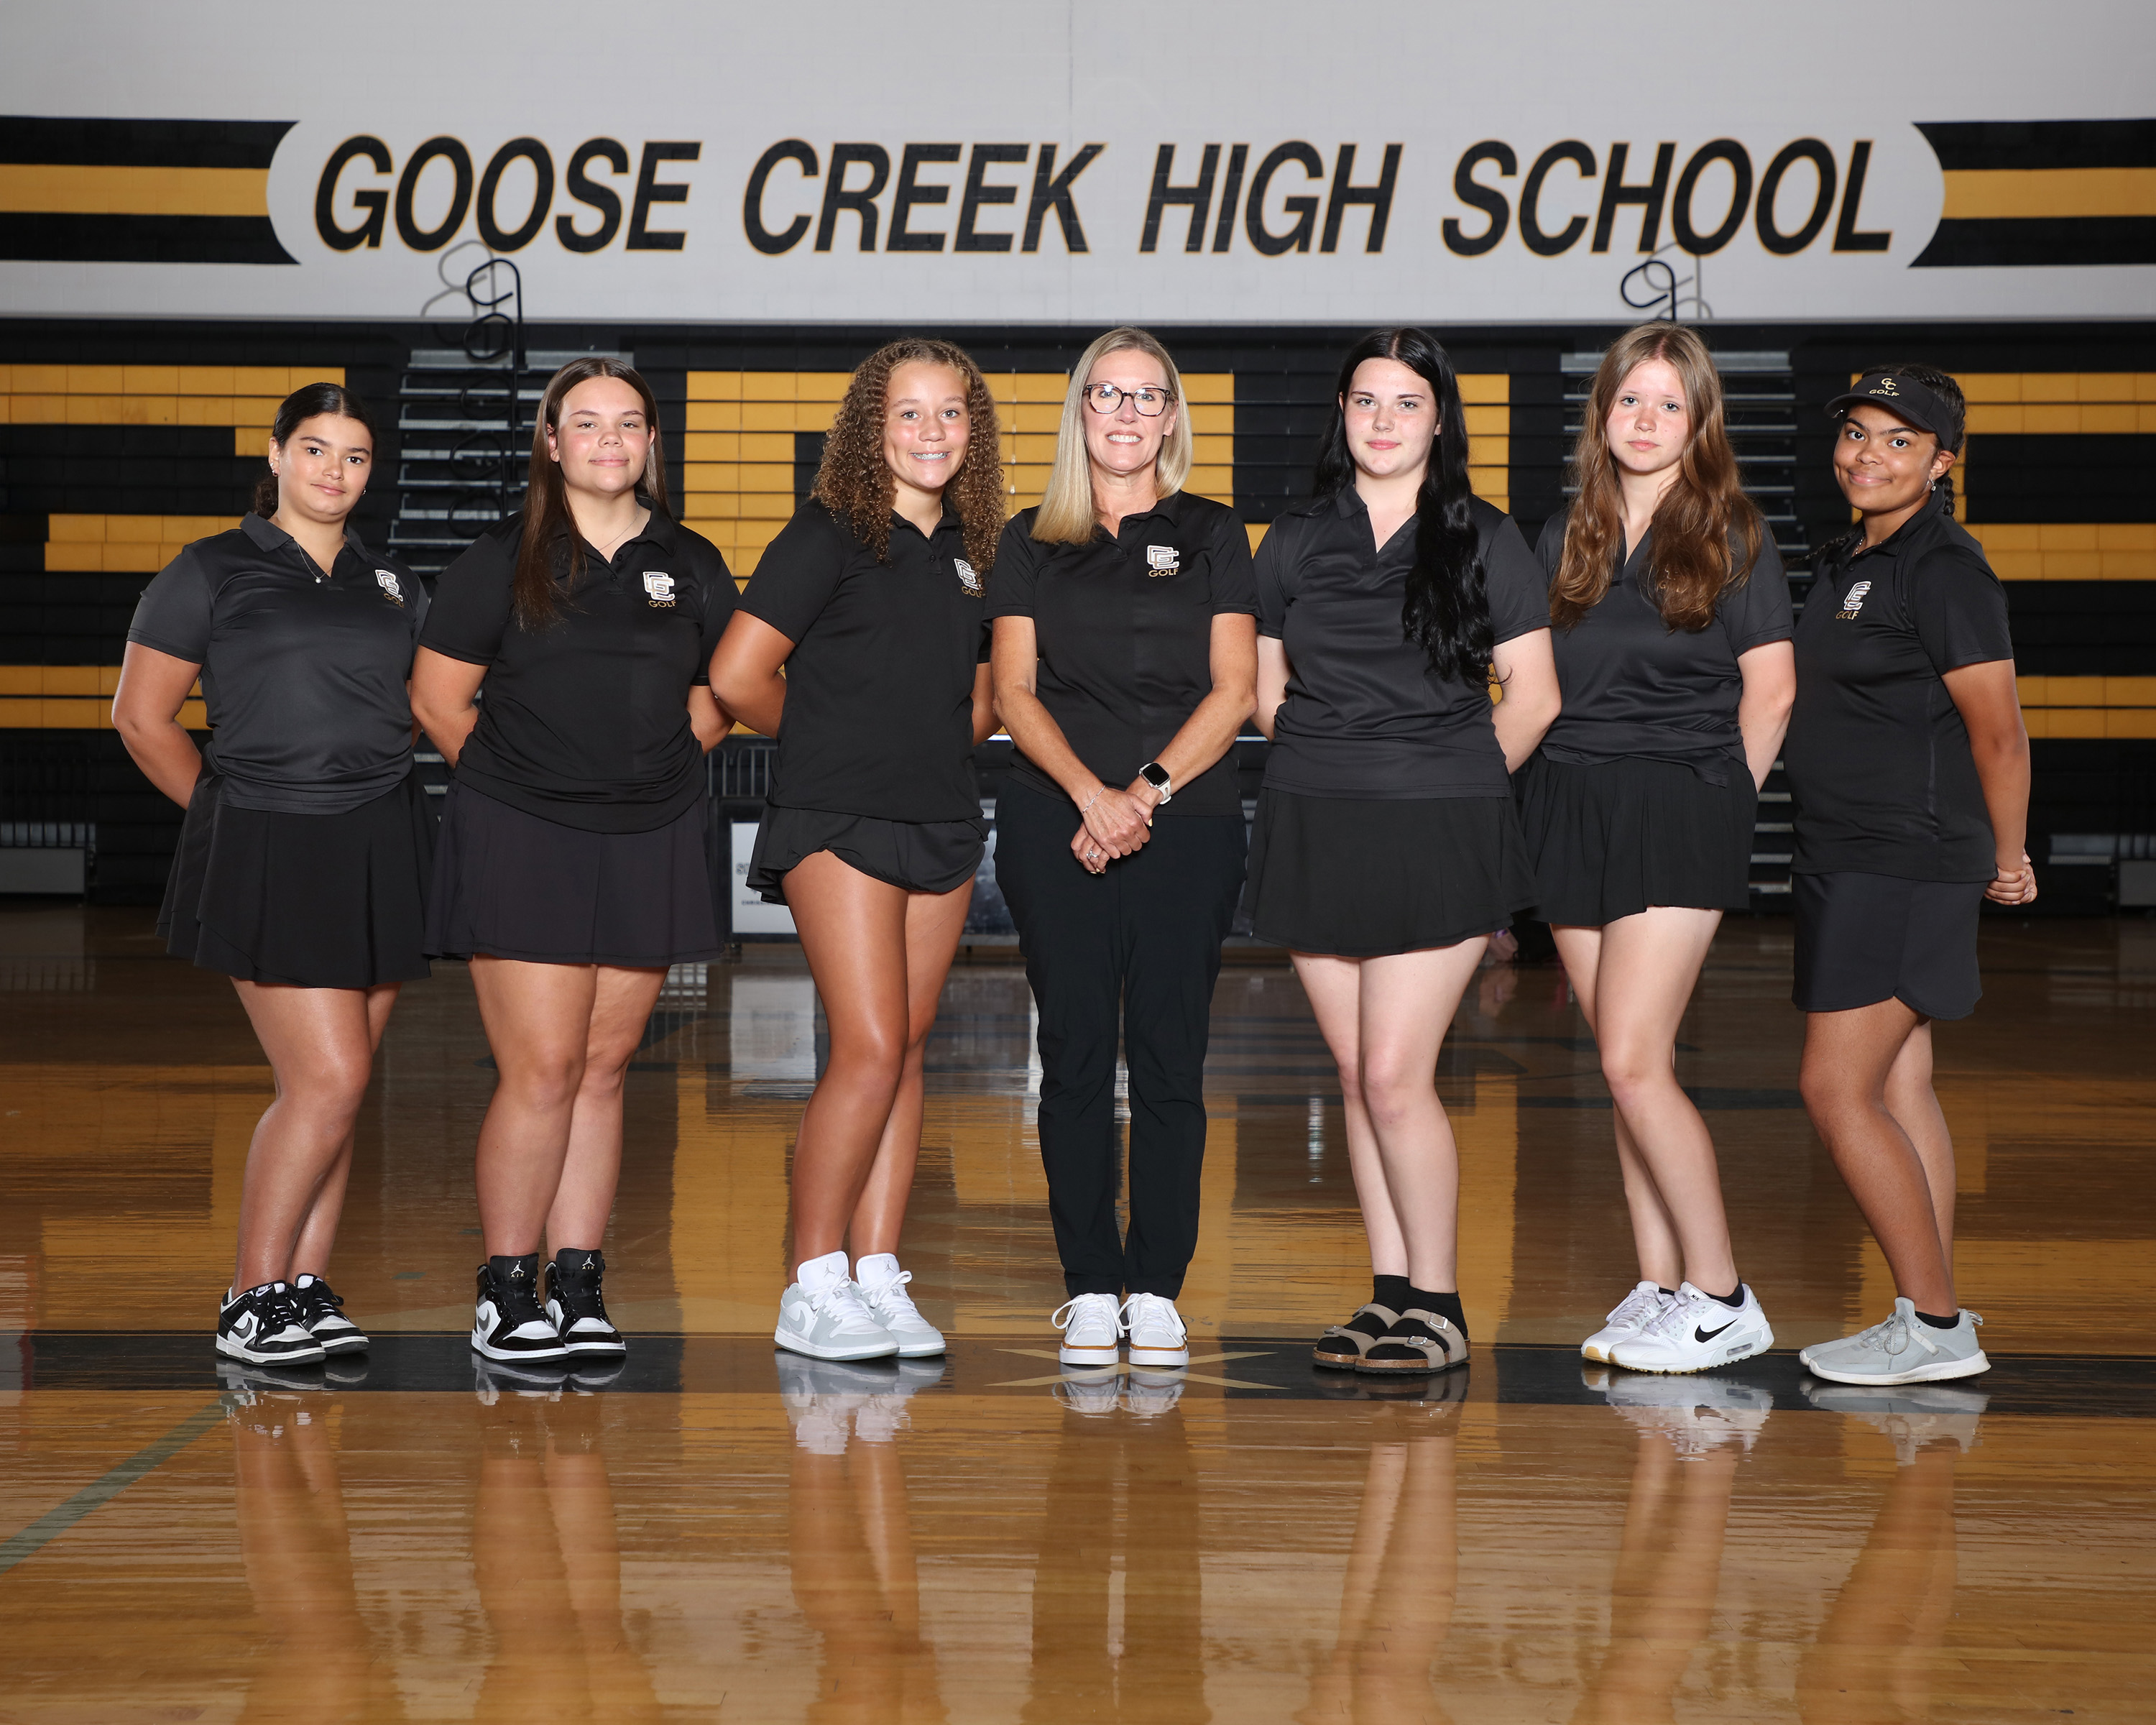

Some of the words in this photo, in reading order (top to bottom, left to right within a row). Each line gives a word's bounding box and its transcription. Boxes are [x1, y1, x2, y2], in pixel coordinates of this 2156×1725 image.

[314, 134, 703, 254] GOOSE
[742, 137, 1107, 255] CREEK
[1139, 139, 1405, 257] HIGH
[1441, 137, 1894, 257] SCHOOL
[1881, 377, 1897, 390] GC
[1148, 568, 1179, 577] GOLF
[1835, 610, 1859, 620] GOLF
